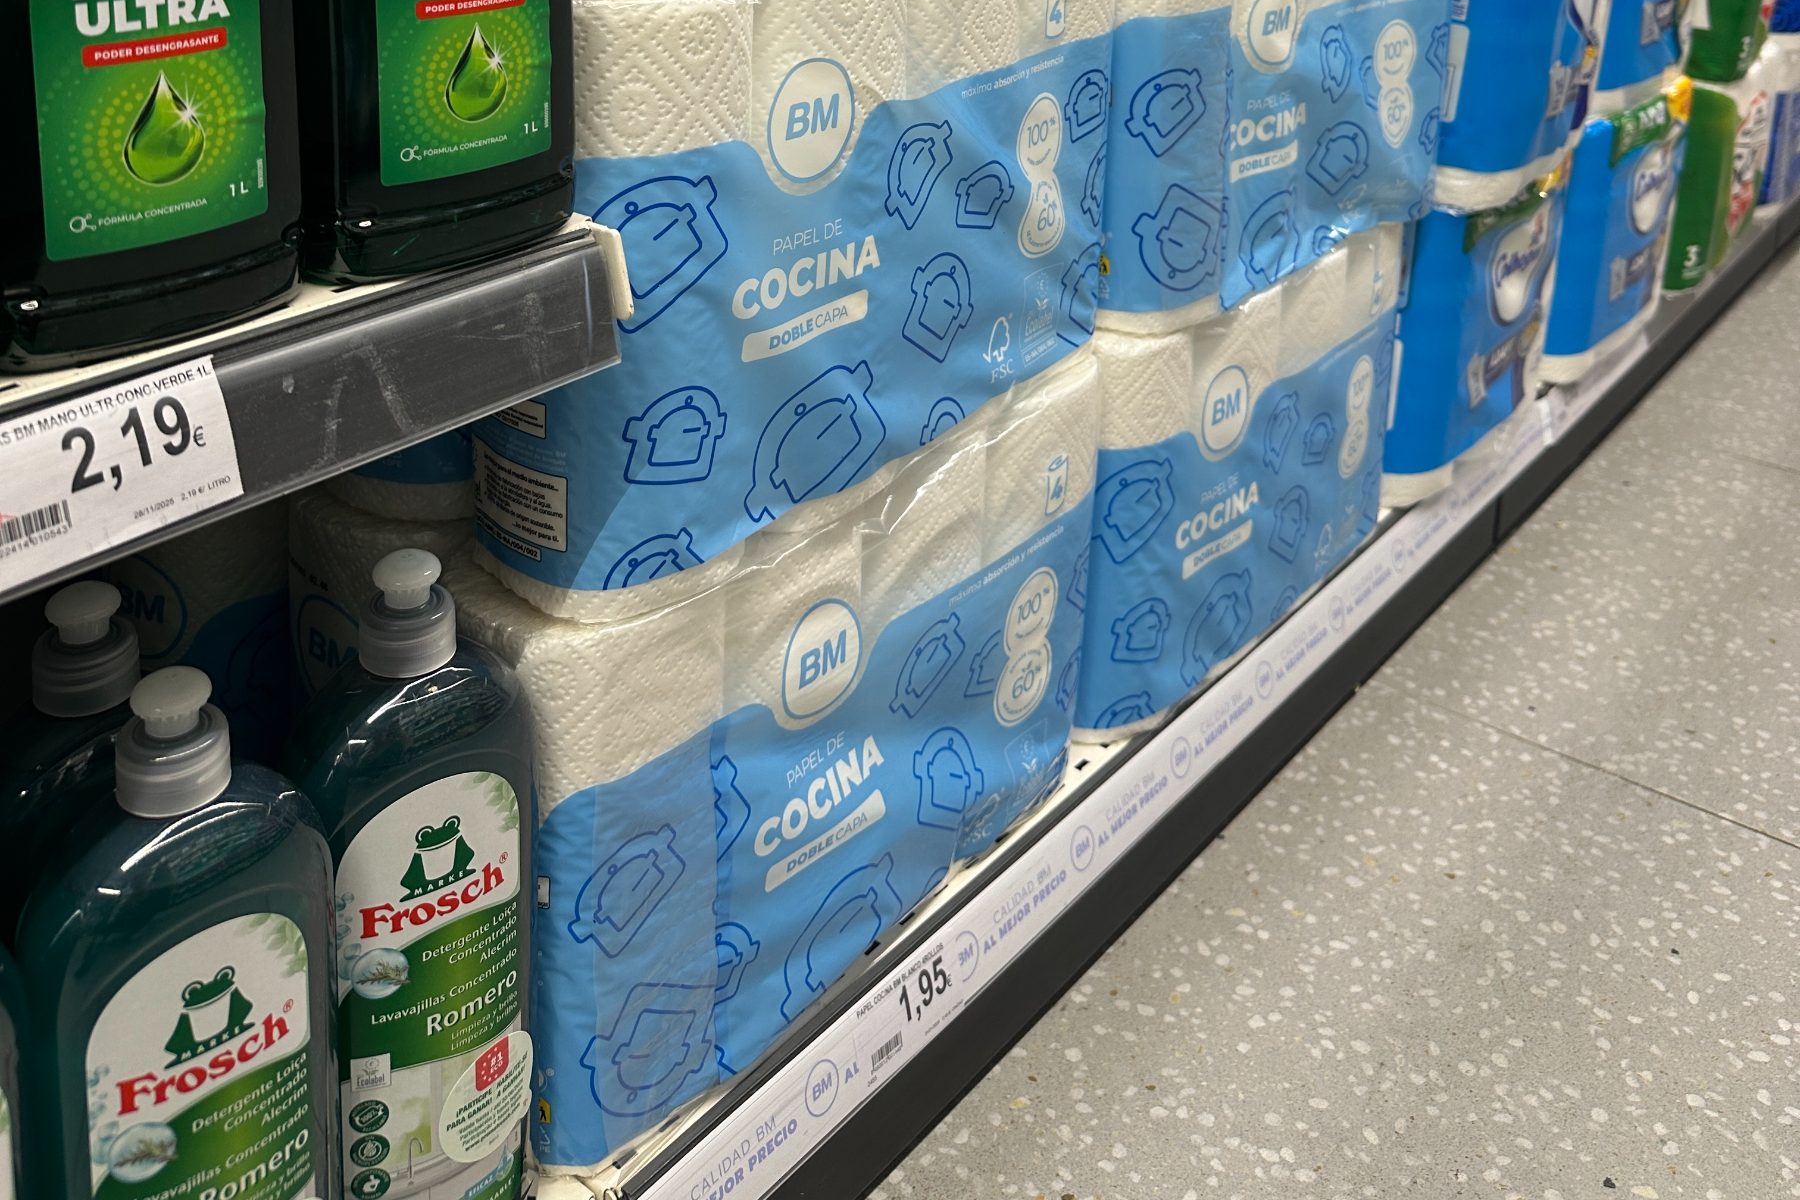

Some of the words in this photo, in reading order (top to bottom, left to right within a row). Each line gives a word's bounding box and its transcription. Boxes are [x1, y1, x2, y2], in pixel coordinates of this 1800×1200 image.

[424, 2, 457, 15] PODER
[1261, 5, 1292, 38] BM
[93, 46, 134, 62] PODER
[134, 33, 221, 57] DESENGRASANTE
[784, 93, 840, 142] BM
[422, 144, 459, 158] FÓRMULA
[458, 133, 509, 152] CONCENTRADA
[1238, 157, 1270, 175] DOBLE
[97, 209, 144, 228] FÓRMULA
[143, 196, 209, 219] CONCENTRADA
[773, 227, 820, 256] PAPEL
[823, 217, 844, 241] DE
[731, 234, 881, 321] COCINA
[768, 317, 815, 351] DOBLE
[814, 304, 849, 329] CAPA
[14, 422, 37, 441] BM
[37, 407, 79, 433] MANO
[195, 363, 213, 380] 1L
[1211, 387, 1242, 428] BM
[1175, 480, 1260, 551] COCINA
[798, 628, 848, 691] BM
[786, 749, 825, 790] PAPEL
[826, 730, 847, 757] DE
[753, 734, 885, 858] COCINA
[1097, 833, 1110, 849] AL
[1110, 806, 1139, 835] MEJOR
[1139, 775, 1169, 804] PRECIO
[786, 833, 834, 874] DOBLE
[834, 811, 869, 843] CAPA
[1074, 836, 1091, 860] BM
[413, 869, 465, 897] MARKE
[421, 922, 490, 963] Detergente
[491, 901, 518, 928] Loiça
[982, 933, 998, 955] AL
[998, 901, 1031, 935] MEJOR
[1032, 869, 1068, 909] PRECIO
[448, 914, 518, 965] Concentrado
[478, 928, 518, 964] Alecrim
[370, 991, 446, 1026] Lavavajillas
[448, 946, 518, 999] Concentrado
[425, 969, 518, 1038] Romero
[855, 1001, 874, 1020] PAPEL
[872, 985, 894, 1006] COCINA
[900, 960, 922, 983] BLANCO
[180, 1025, 242, 1062] MARKE
[450, 1011, 492, 1042] Limpieza
[191, 1079, 274, 1134] Detergente
[275, 1052, 308, 1083] Loiça
[223, 1067, 308, 1133] Concentrado
[356, 1072, 386, 1087] Ecolabel
[811, 1071, 833, 1103] BM
[844, 1060, 861, 1085] AL
[260, 1082, 309, 1128] Alecrim
[446, 1117, 467, 1133] PARA
[466, 1098, 493, 1120] GANAR!
[224, 1102, 309, 1171] Concentrado
[690, 1138, 751, 1200] CALIDAD
[755, 1114, 777, 1142] BM
[747, 1117, 799, 1173] PRECIO
